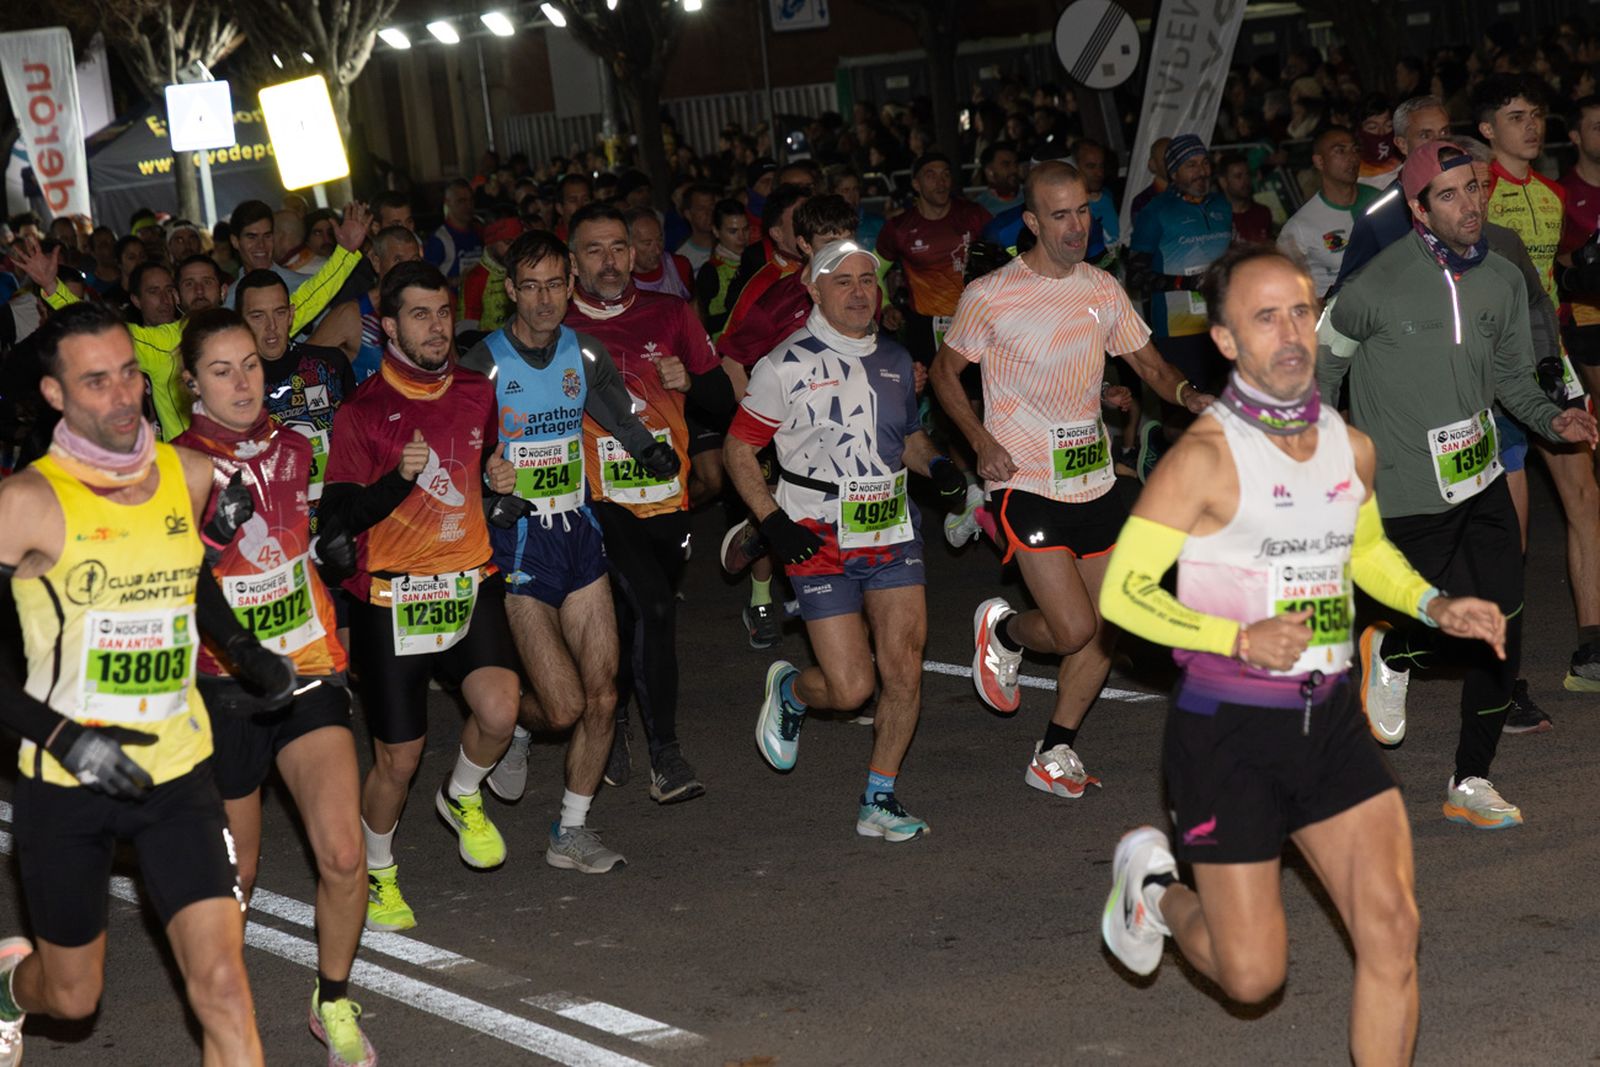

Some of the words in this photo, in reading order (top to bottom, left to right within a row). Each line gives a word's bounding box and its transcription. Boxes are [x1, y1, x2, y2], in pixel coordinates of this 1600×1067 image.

[1066, 430, 1088, 438] NOCHE
[1058, 440, 1074, 449] SAN
[1441, 441, 1460, 453] SAN
[528, 449, 552, 458] NOCHE
[553, 447, 562, 455] DE
[1065, 441, 1104, 471] 2562
[1452, 434, 1490, 474] 1390
[519, 459, 535, 467] SAN
[533, 465, 570, 490] 254
[429, 475, 449, 496] 43
[859, 484, 882, 492] NOCHE
[883, 481, 891, 489] DE
[848, 493, 865, 501] SAN
[854, 498, 898, 525] 4929
[257, 545, 281, 570] 43
[1297, 568, 1328, 581] NOCHE
[108, 573, 143, 590] CLUB
[249, 581, 276, 594] NOCHE
[277, 574, 288, 586] DE
[411, 584, 437, 592] NOCHE
[119, 585, 194, 604] MONTILL
[402, 592, 420, 602] SAN
[1283, 585, 1306, 598] SAN
[238, 596, 259, 607] SAN
[243, 589, 306, 633] 12972
[403, 600, 469, 627] 12585
[115, 622, 149, 636] NOCHE
[151, 622, 164, 633] DE
[98, 637, 123, 648] SAN
[97, 648, 187, 684] 13803
